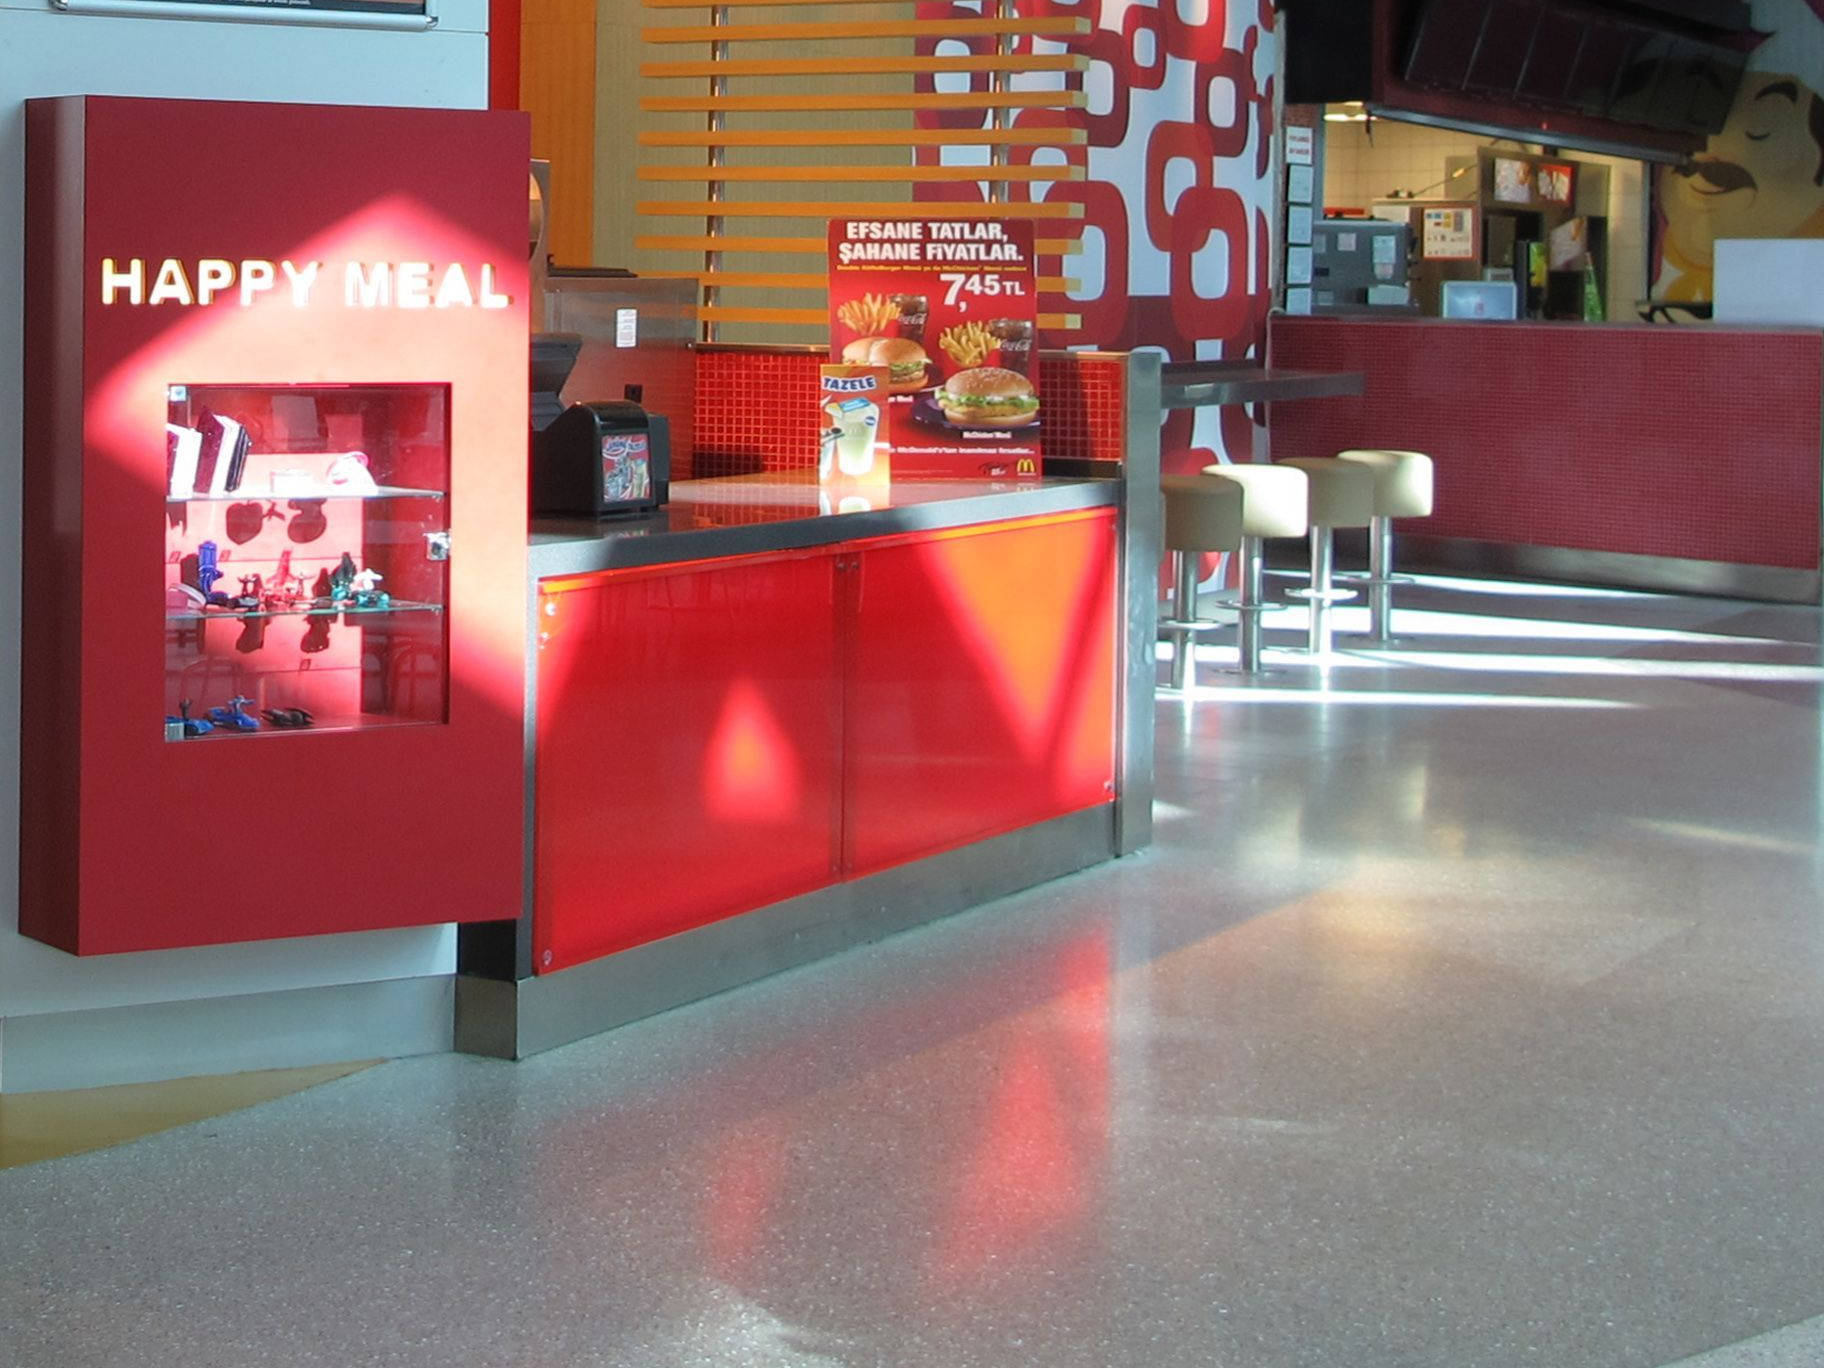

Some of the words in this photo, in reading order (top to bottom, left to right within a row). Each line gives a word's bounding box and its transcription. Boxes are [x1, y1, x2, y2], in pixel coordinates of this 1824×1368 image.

[847, 222, 923, 239] EFSANE
[928, 222, 1008, 242] TATLAR,
[839, 243, 920, 264] ŞAHANE
[101, 258, 322, 308] HAPPY
[344, 261, 513, 310] MEAL
[940, 273, 1002, 312] 7,45
[1002, 281, 1025, 296] TL
[823, 376, 875, 391] TAZELE
